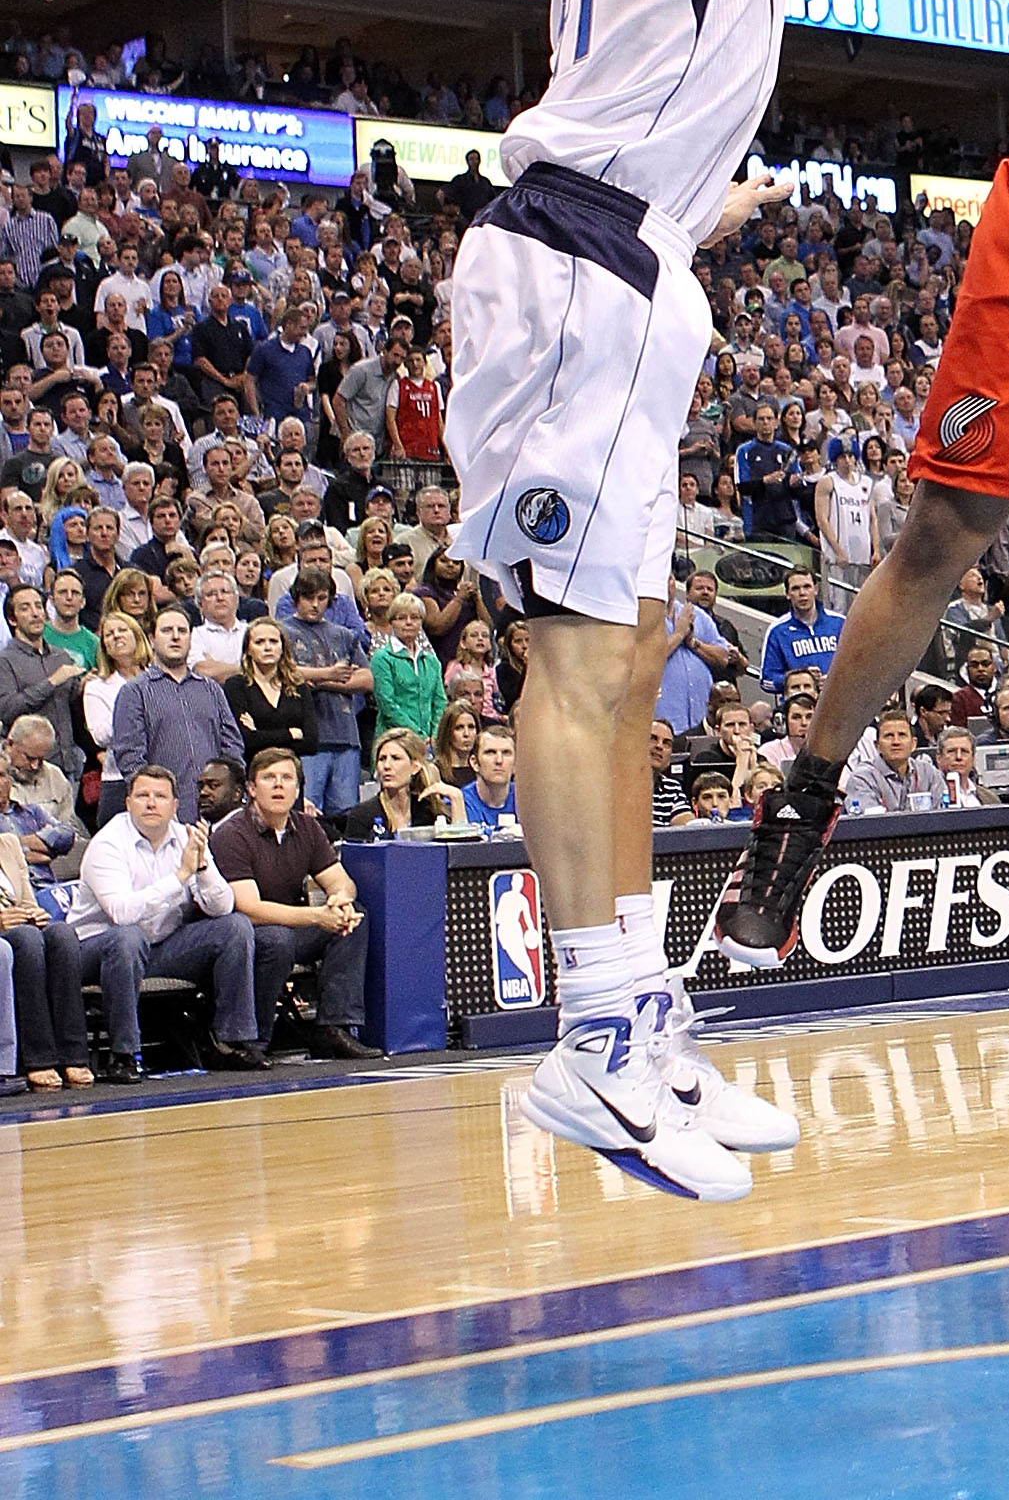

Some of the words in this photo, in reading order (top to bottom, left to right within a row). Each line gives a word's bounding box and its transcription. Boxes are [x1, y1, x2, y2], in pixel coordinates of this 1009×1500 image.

[0, 99, 47, 135] F'S
[105, 97, 195, 127] WELCOME
[106, 127, 184, 162] Amca
[416, 400, 430, 418] 41
[850, 510, 861, 526] 14
[792, 636, 837, 658] DALLAS
[502, 977, 530, 999] NBA
